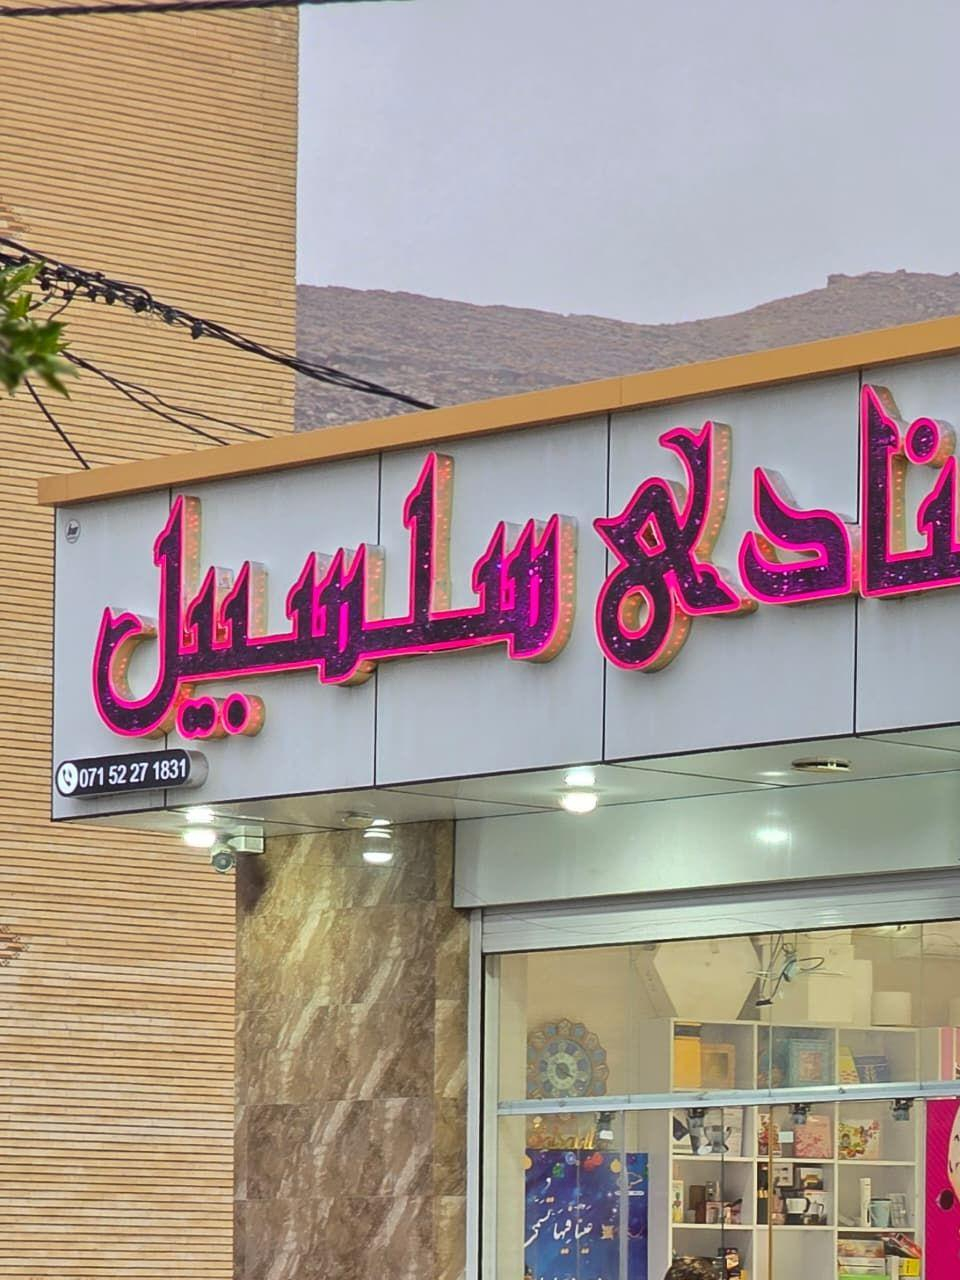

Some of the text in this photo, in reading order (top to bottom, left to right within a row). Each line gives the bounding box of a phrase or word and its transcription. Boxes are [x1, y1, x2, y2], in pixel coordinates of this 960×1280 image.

[93, 454, 558, 738] سلسبیل
[79, 758, 186, 788] 071 52 27 1831
